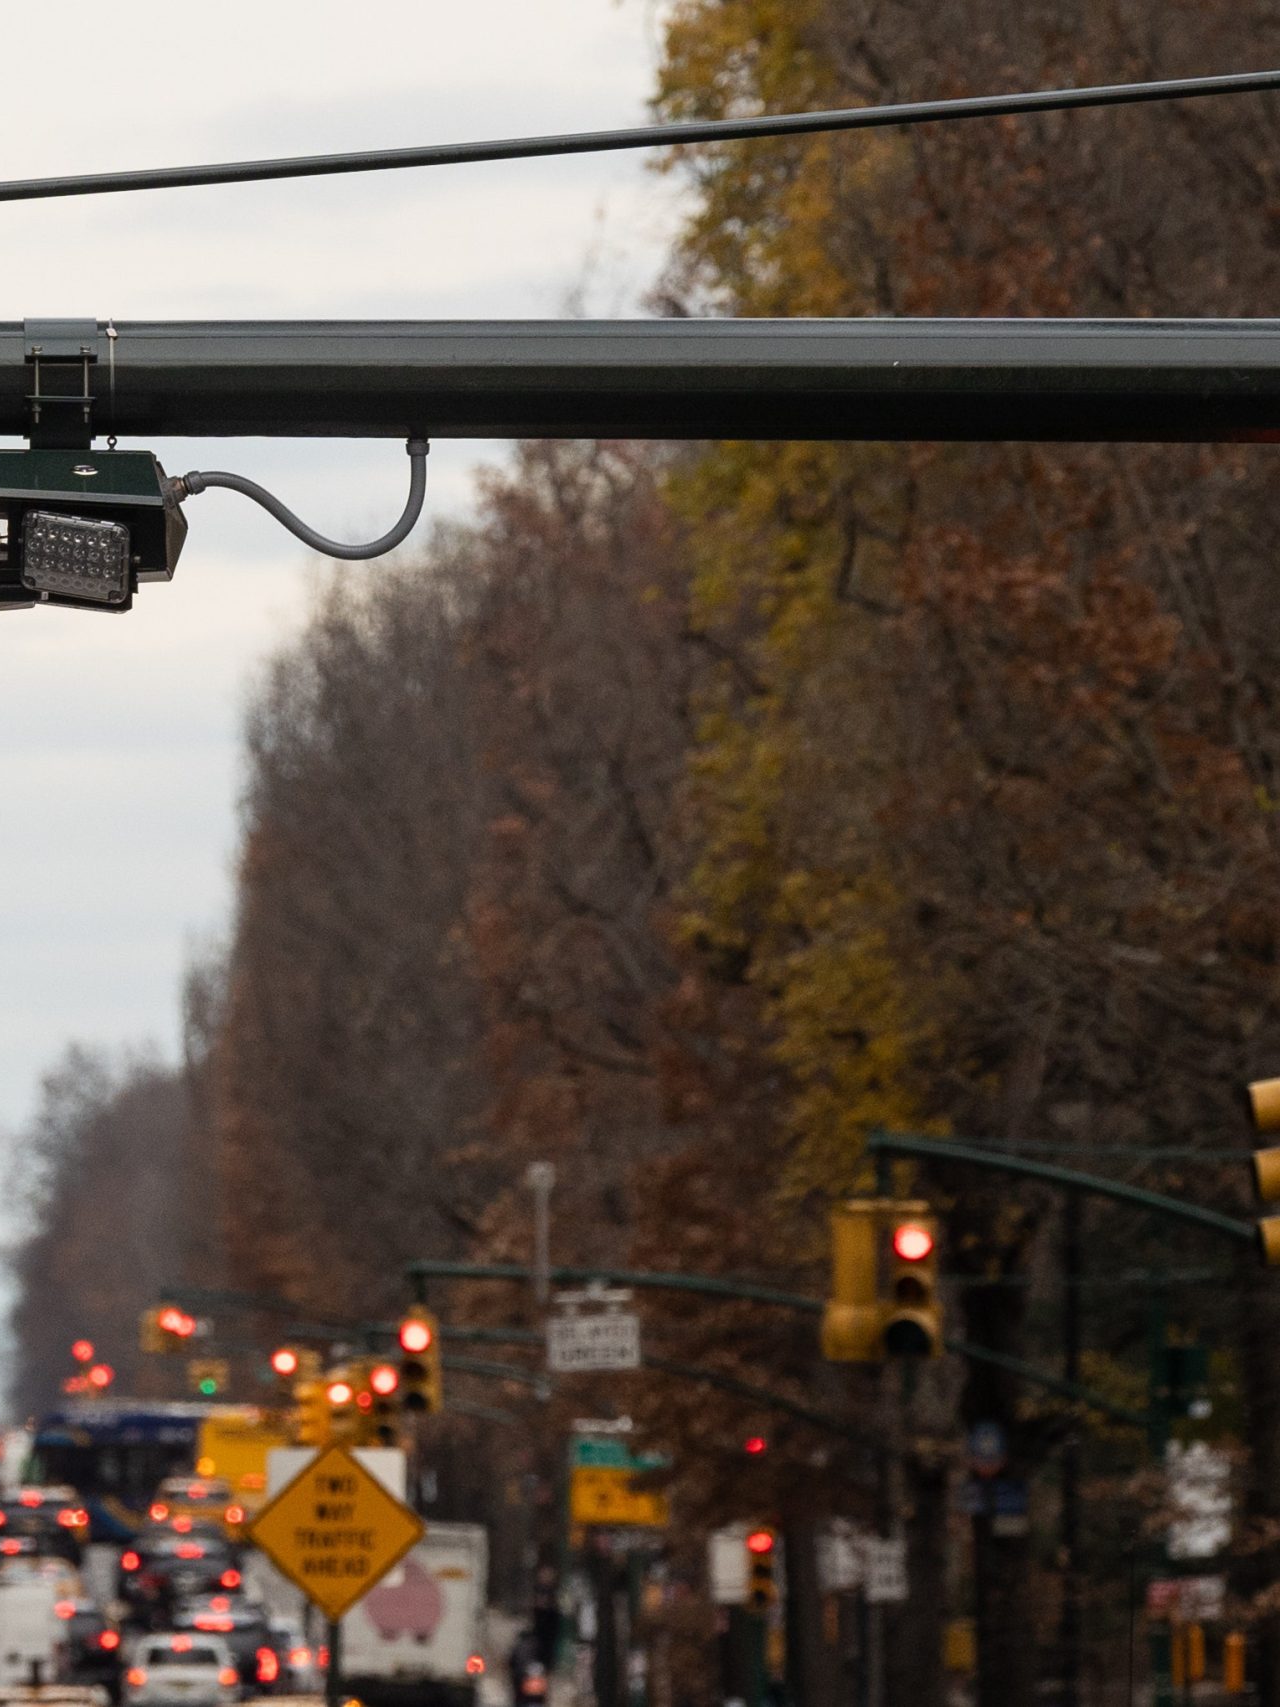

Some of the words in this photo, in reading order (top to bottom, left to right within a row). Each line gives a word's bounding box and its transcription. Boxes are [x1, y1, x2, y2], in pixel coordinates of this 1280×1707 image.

[315, 1474, 359, 1494] TWO
[315, 1502, 354, 1521] WAY
[295, 1527, 375, 1549] TRAFFIC
[302, 1556, 369, 1577] AHEAD
